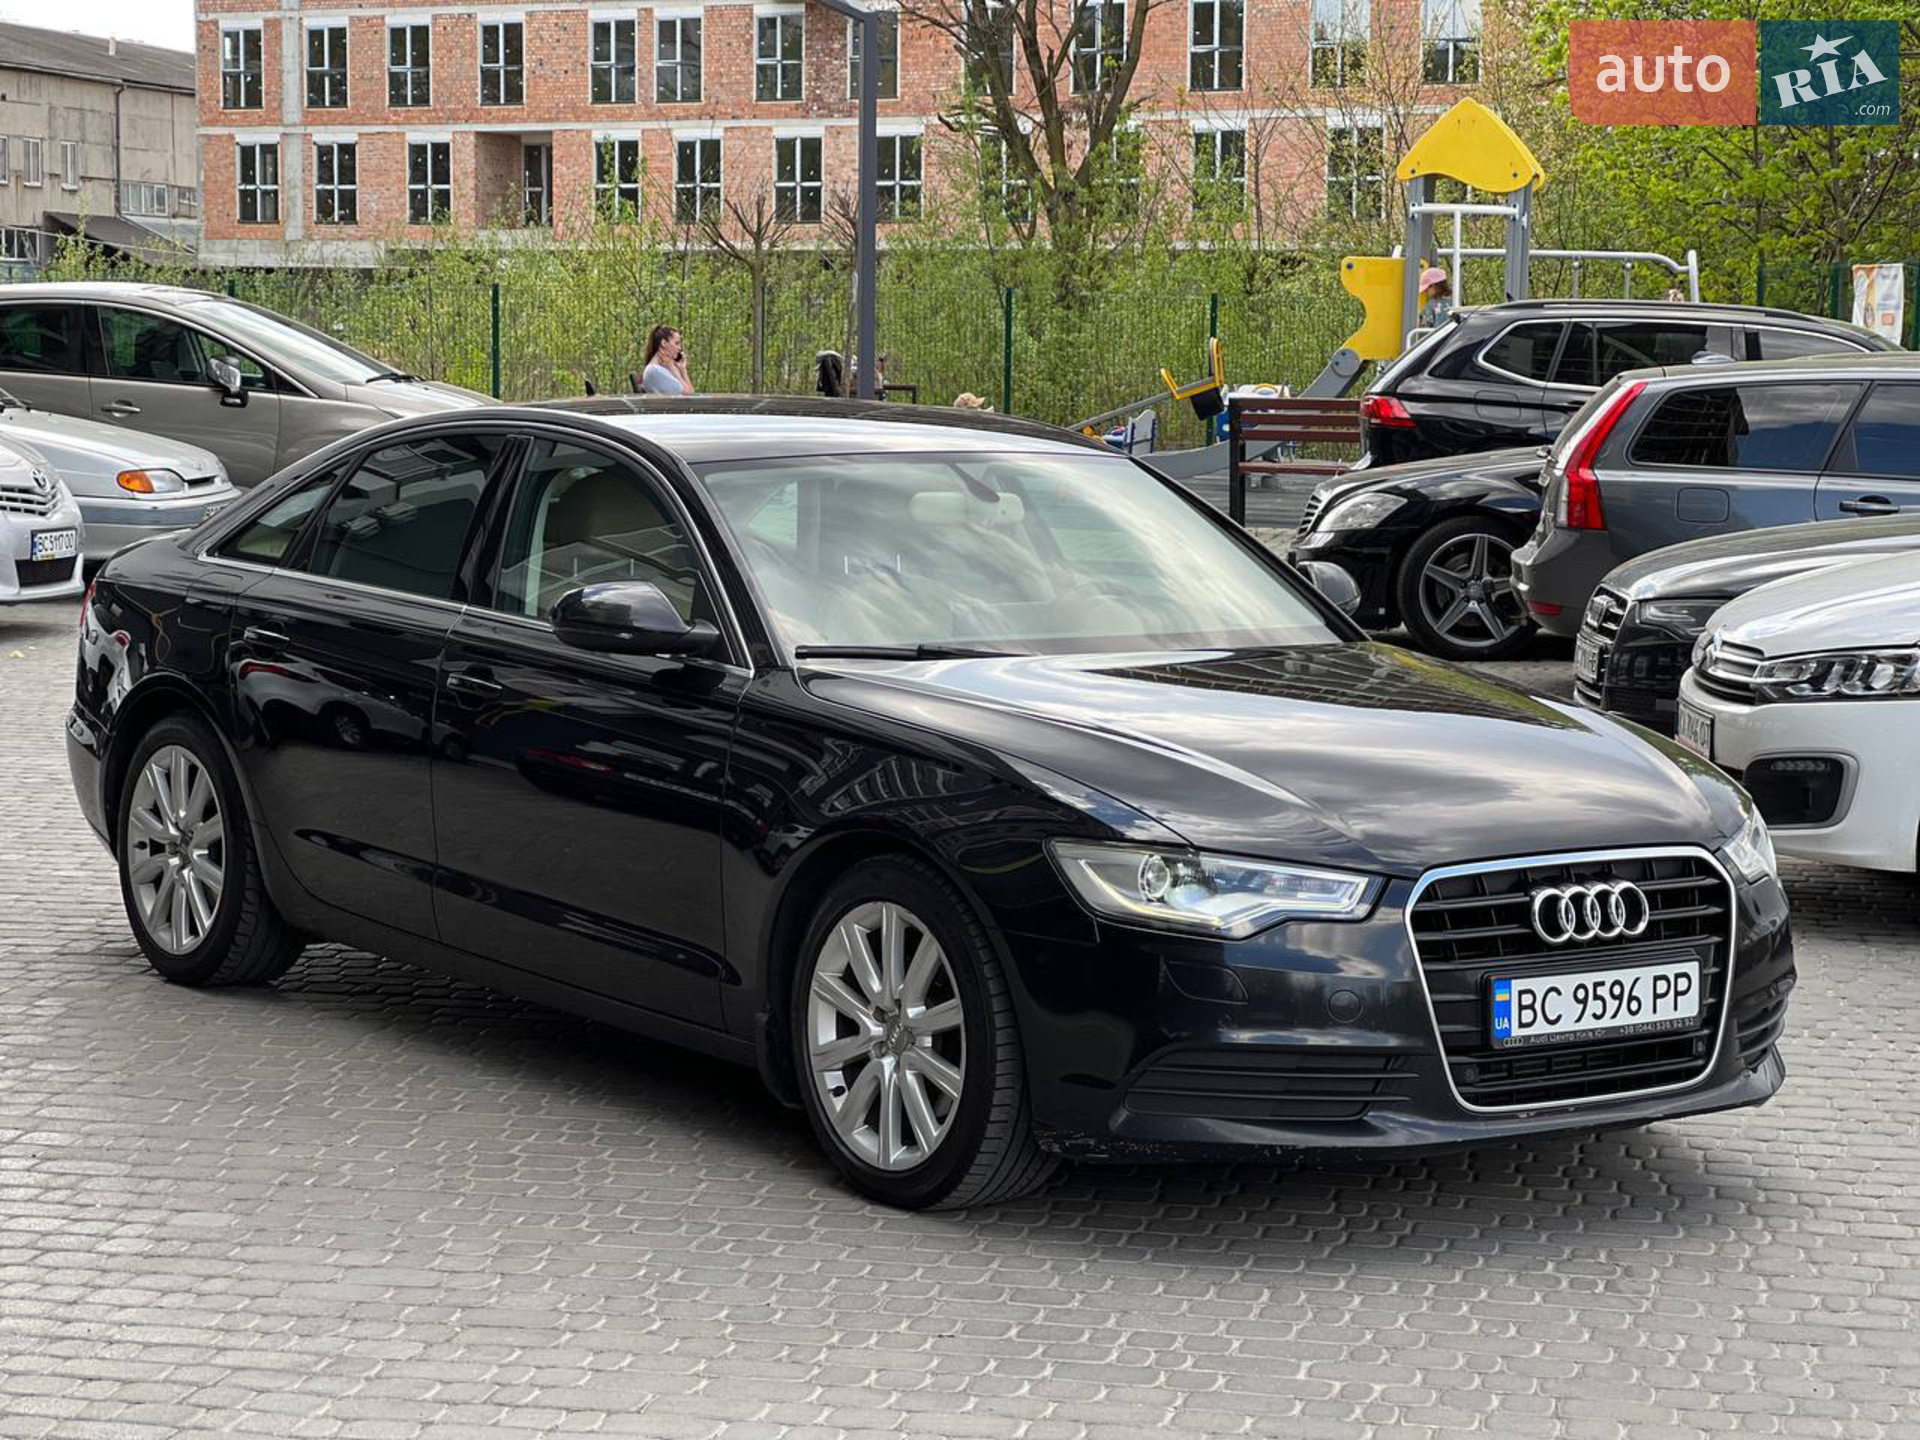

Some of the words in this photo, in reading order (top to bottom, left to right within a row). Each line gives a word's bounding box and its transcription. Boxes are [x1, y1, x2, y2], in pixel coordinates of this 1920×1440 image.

[1517, 986, 1562, 1029] BC
[1573, 977, 1642, 1024] 9596
[1652, 971, 1693, 1015] PP
[1495, 1017, 1510, 1030] UA
